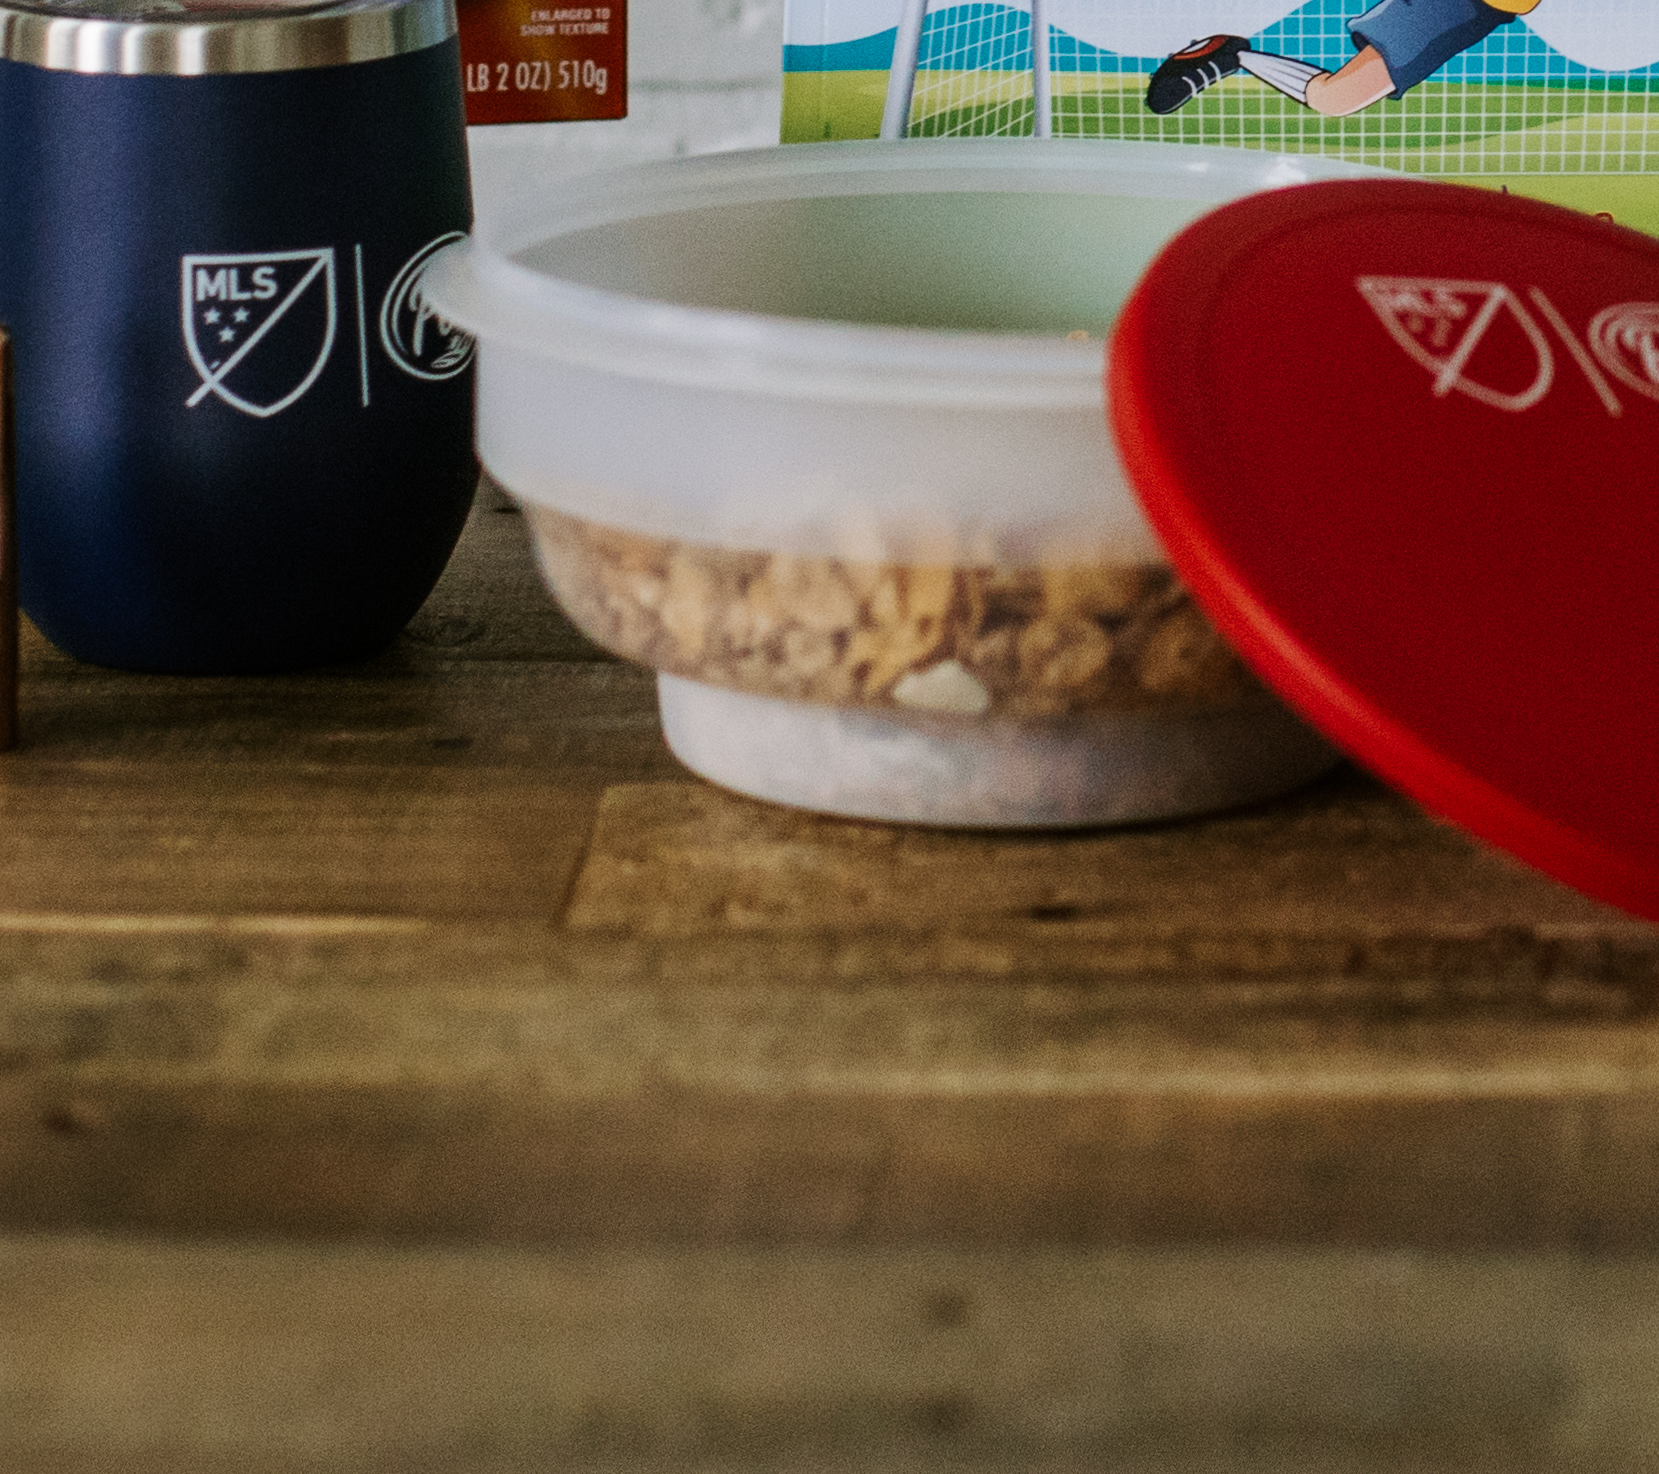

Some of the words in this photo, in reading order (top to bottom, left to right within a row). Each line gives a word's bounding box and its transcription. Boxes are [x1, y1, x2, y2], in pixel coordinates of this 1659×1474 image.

[531, 8, 592, 22] ENLARGED
[595, 7, 610, 19] TO
[520, 24, 555, 37] SHOW
[559, 22, 609, 36] TEXTURE
[466, 63, 489, 92] LB
[496, 62, 509, 91] 2
[515, 61, 551, 92] OZ)
[559, 59, 608, 95] 510g
[196, 265, 278, 302] MLS
